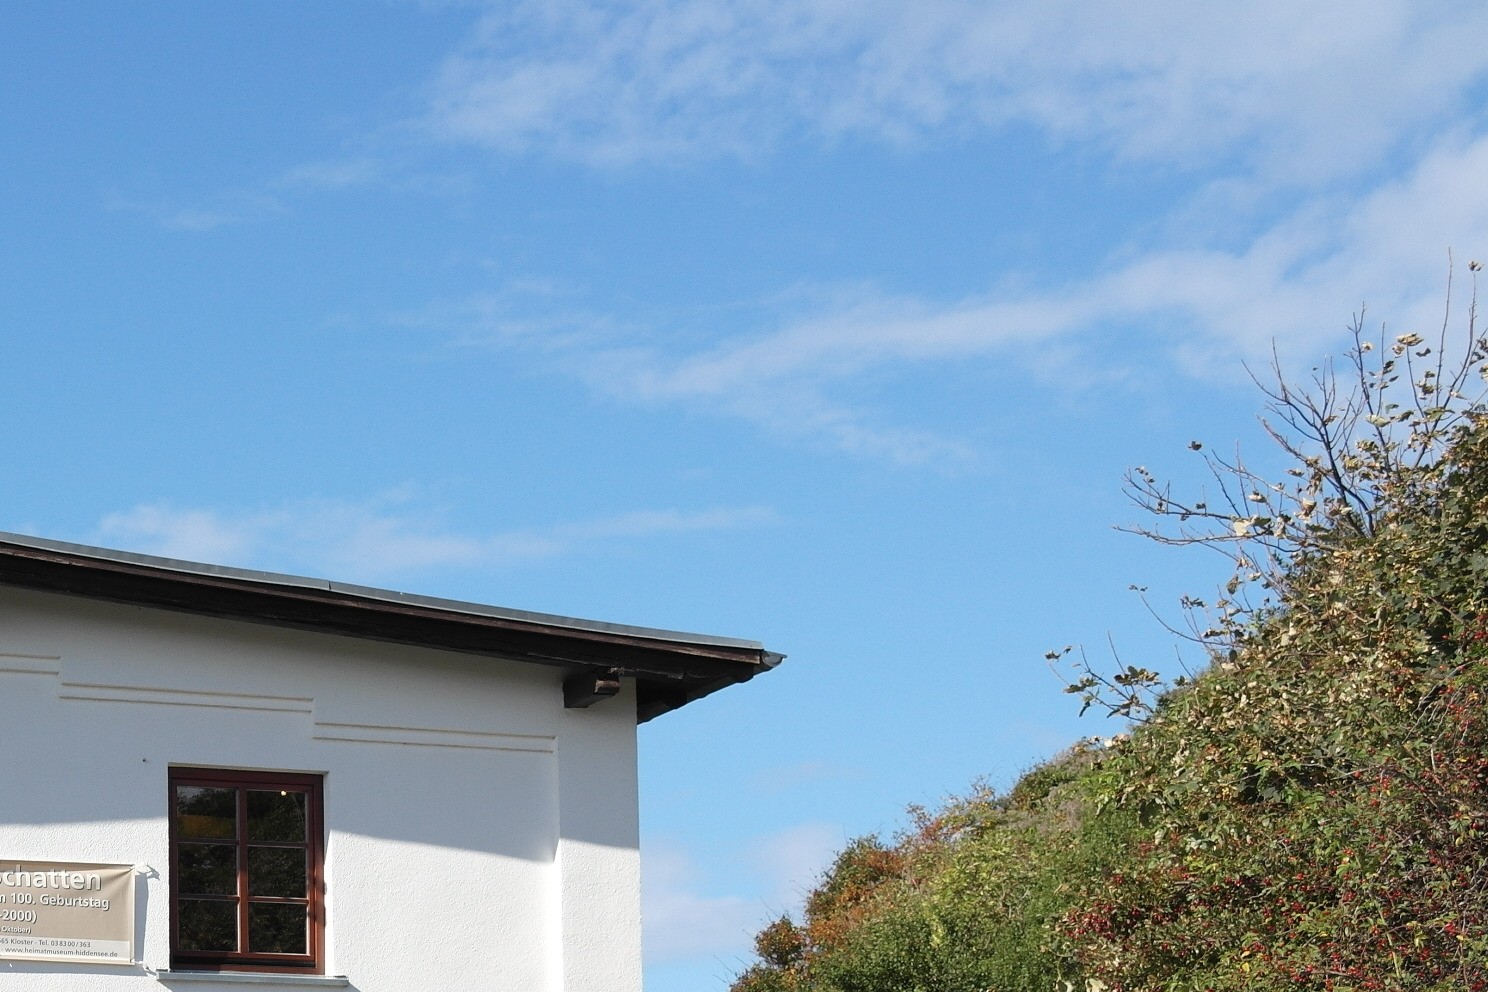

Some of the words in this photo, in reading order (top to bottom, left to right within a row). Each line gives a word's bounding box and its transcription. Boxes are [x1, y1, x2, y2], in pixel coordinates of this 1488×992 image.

[11, 892, 36, 905] 100.
[39, 893, 110, 911] Geburtstag
[10, 938, 33, 946] Kloster
[5, 946, 118, 958] www.heimatmuseum-hiddensee.de
